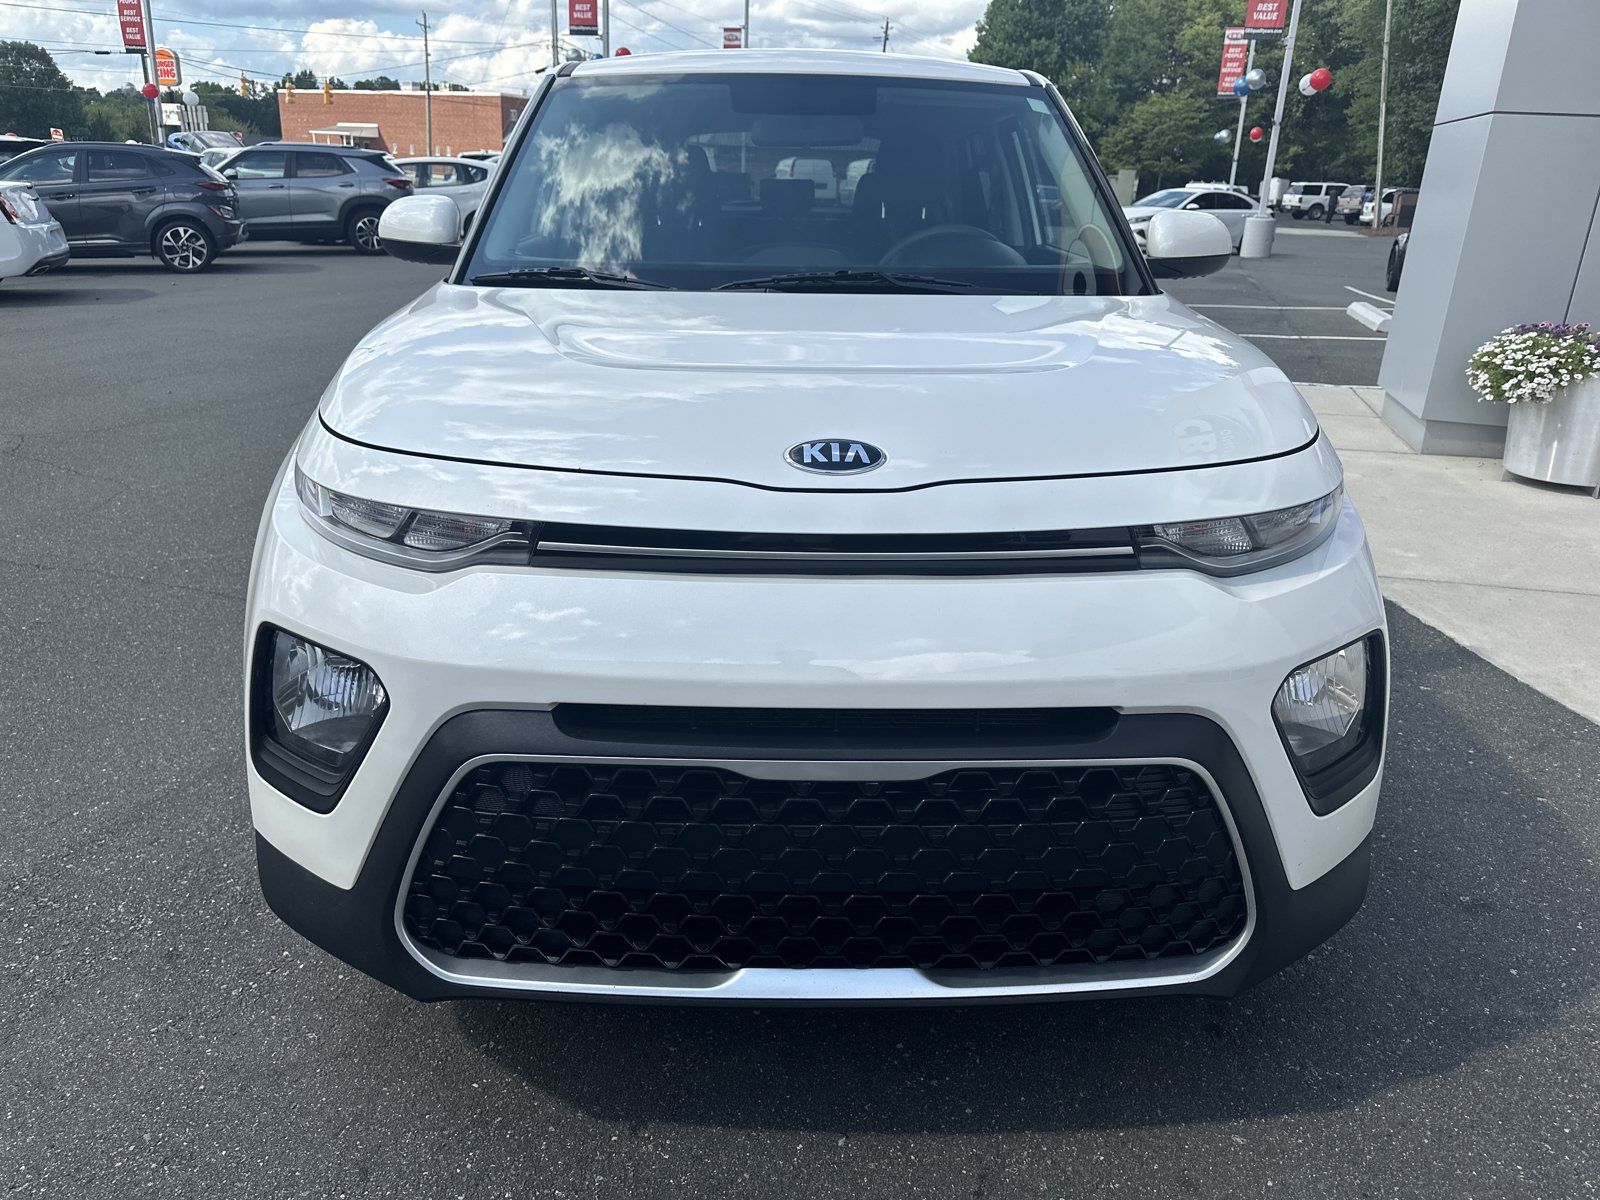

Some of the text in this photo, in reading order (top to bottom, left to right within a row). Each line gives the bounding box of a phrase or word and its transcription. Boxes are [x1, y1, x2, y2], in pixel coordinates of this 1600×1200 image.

[574, 3, 591, 11] BEST
[1256, 2, 1279, 11] BEST
[573, 11, 592, 19] VALUE
[1253, 11, 1279, 20] VALUE
[157, 60, 175, 68] URGER
[158, 67, 176, 79] ING
[802, 442, 871, 464] KIA
